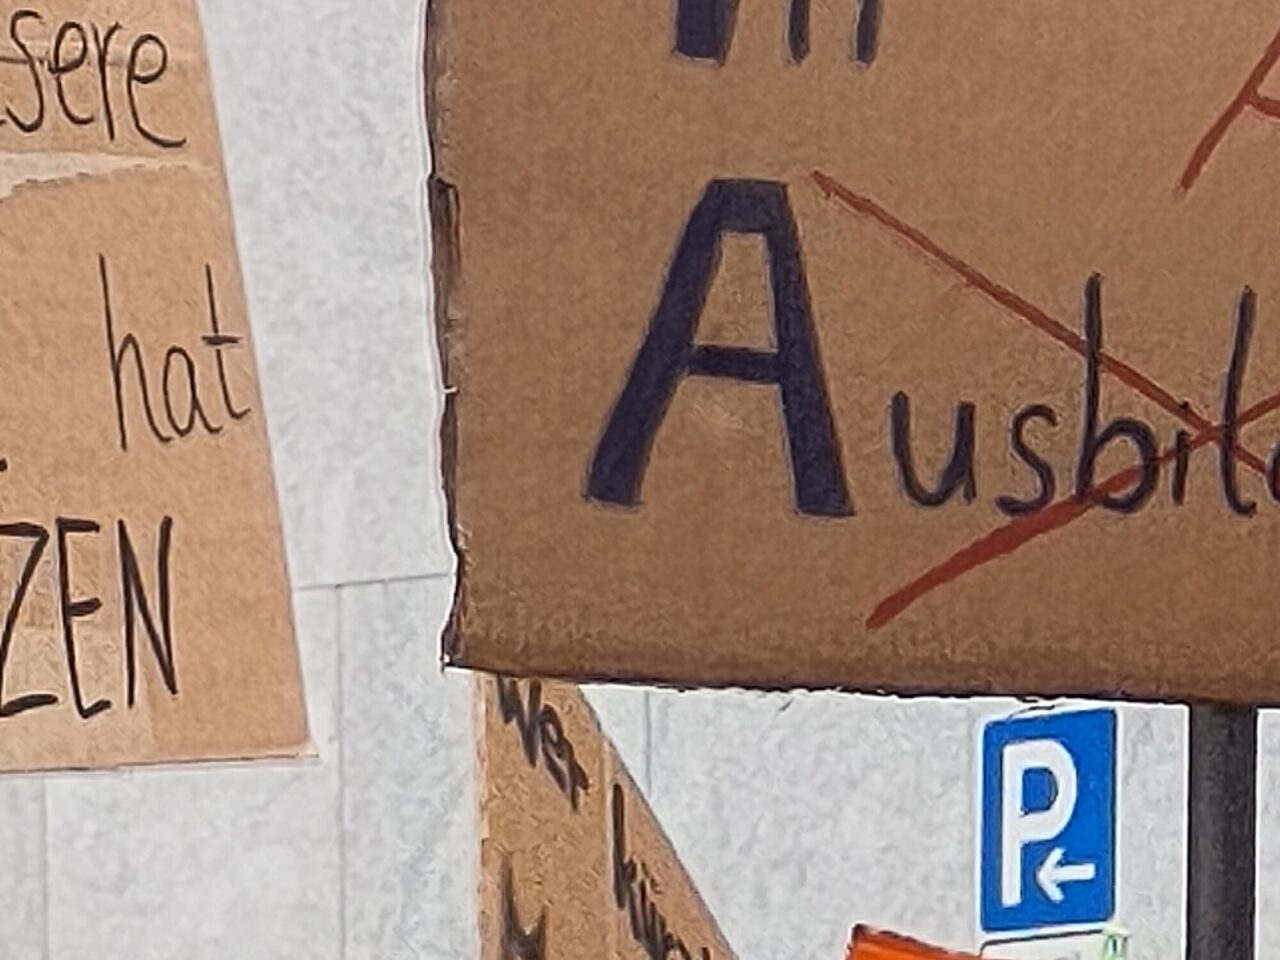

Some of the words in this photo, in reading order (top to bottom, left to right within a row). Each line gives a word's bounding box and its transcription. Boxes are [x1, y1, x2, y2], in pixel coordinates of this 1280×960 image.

[0, 8, 188, 149] sere
[98, 252, 252, 452] hat
[1001, 739, 1078, 909] P
